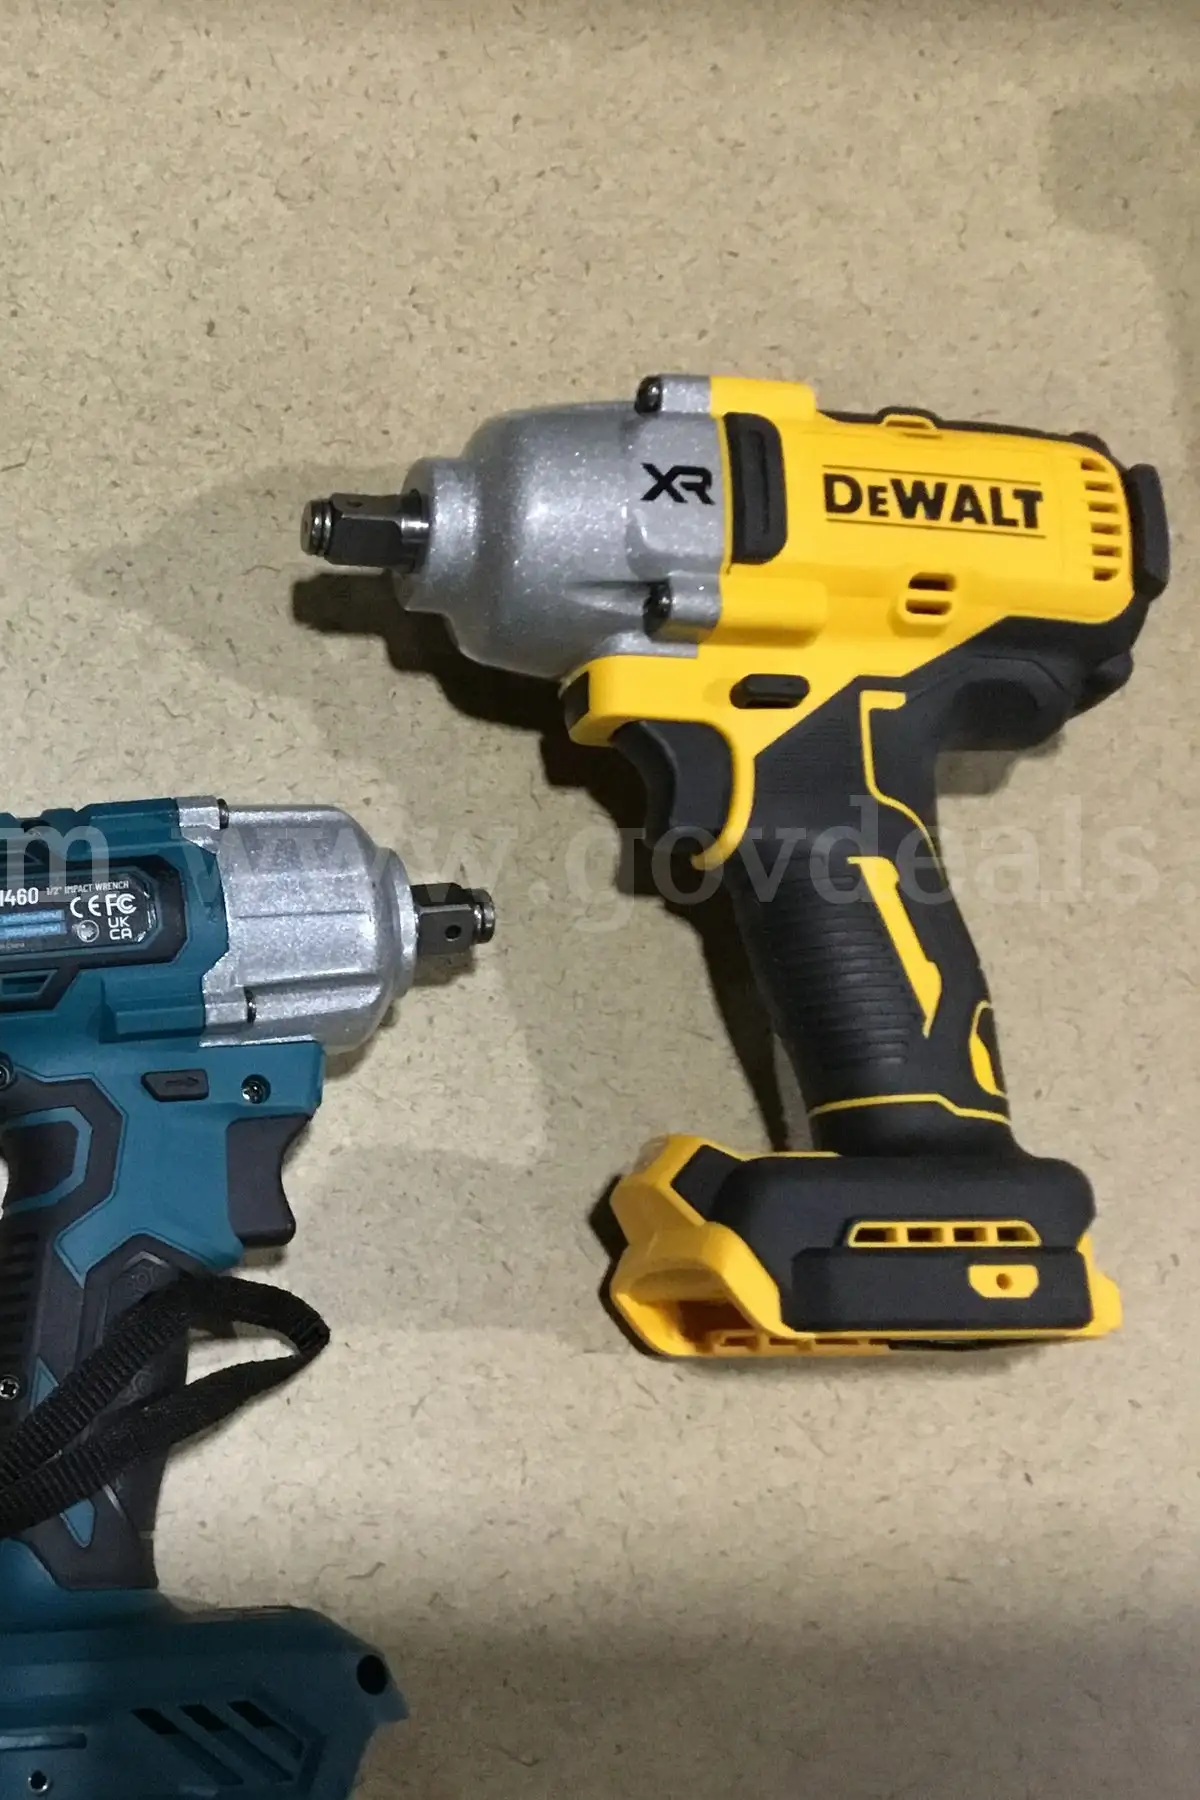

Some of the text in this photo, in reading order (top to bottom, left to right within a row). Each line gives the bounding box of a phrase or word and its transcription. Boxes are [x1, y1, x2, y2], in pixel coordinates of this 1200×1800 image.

[640, 463, 715, 505] XR
[64, 883, 93, 894] IMPACT
[95, 880, 129, 891] WRENCH
[108, 915, 130, 928] UK
[109, 928, 132, 940] CA
